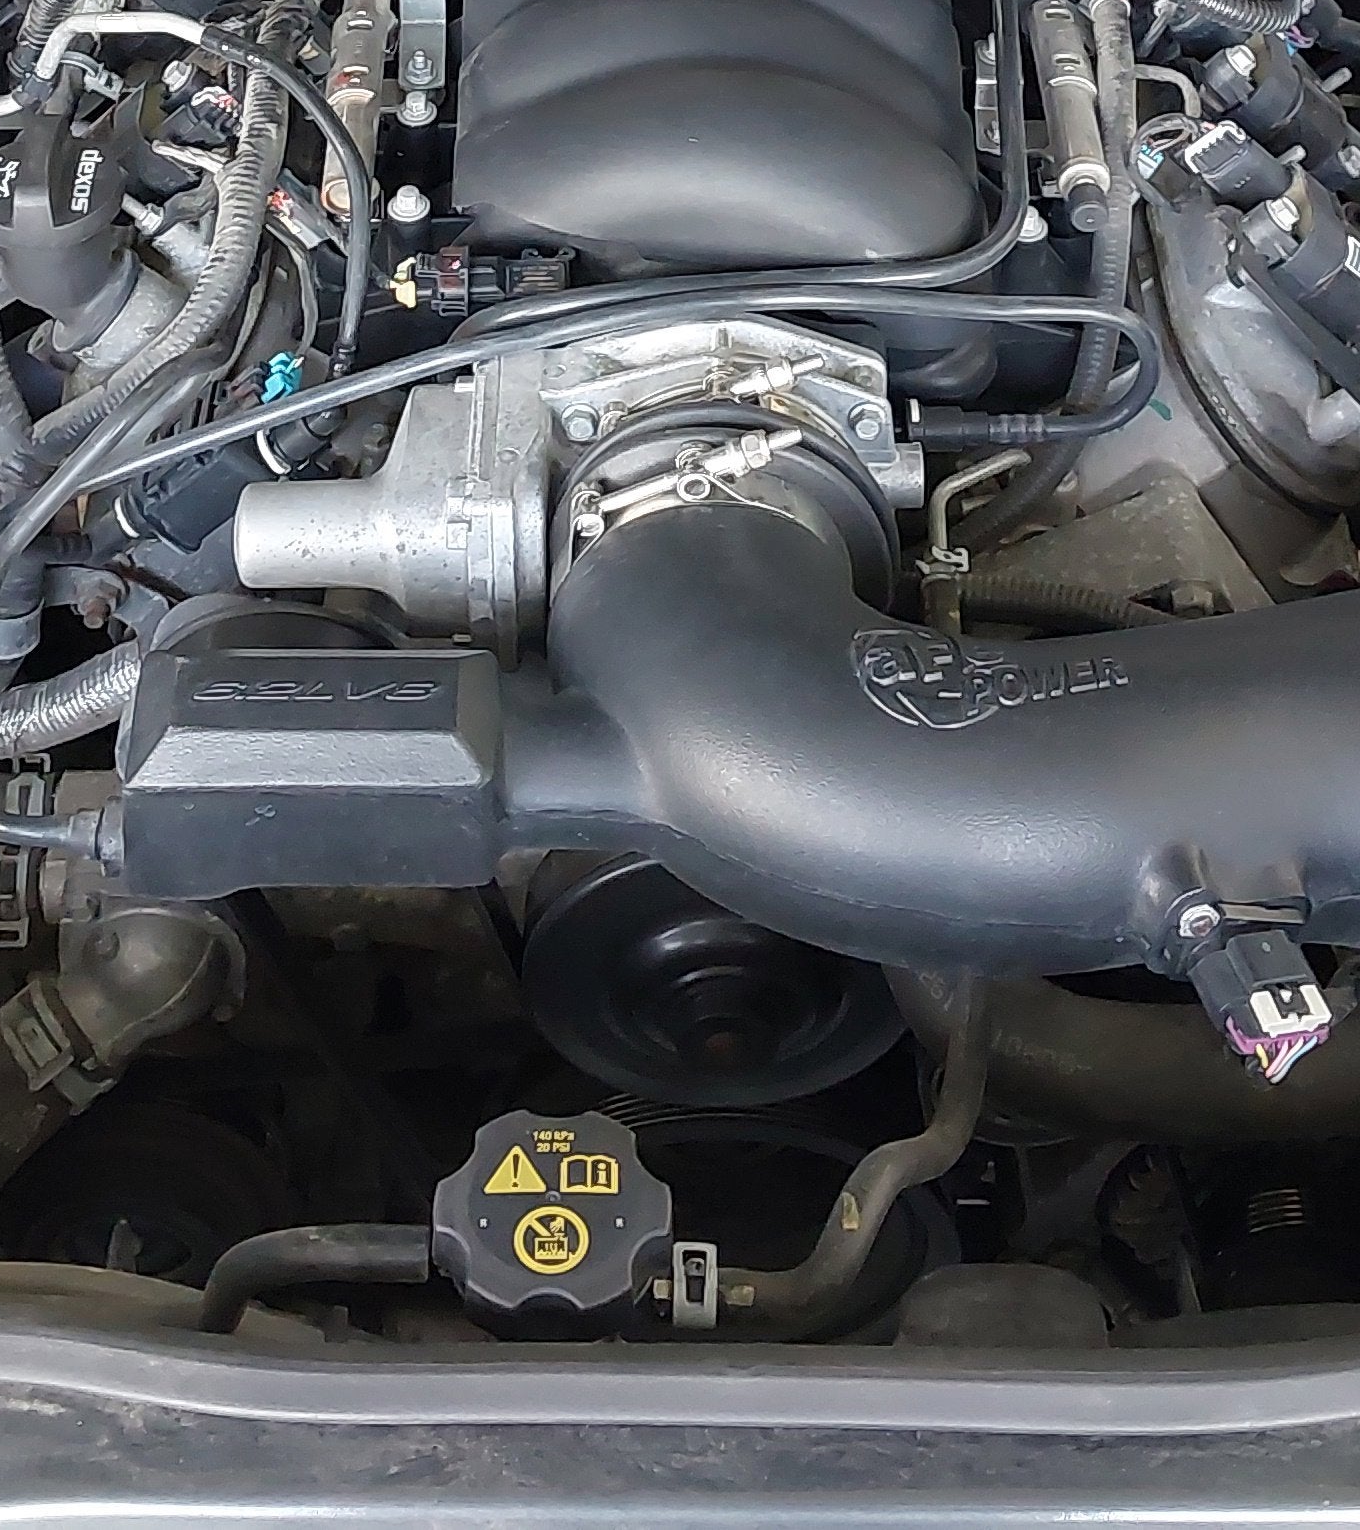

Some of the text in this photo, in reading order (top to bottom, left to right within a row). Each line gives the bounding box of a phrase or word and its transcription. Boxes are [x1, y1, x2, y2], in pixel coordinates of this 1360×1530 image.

[70, 149, 105, 214] dexos
[192, 680, 440, 702] 6.2L V8
[532, 1130, 553, 1141] 140
[536, 1142, 571, 1153] 20 PSI
